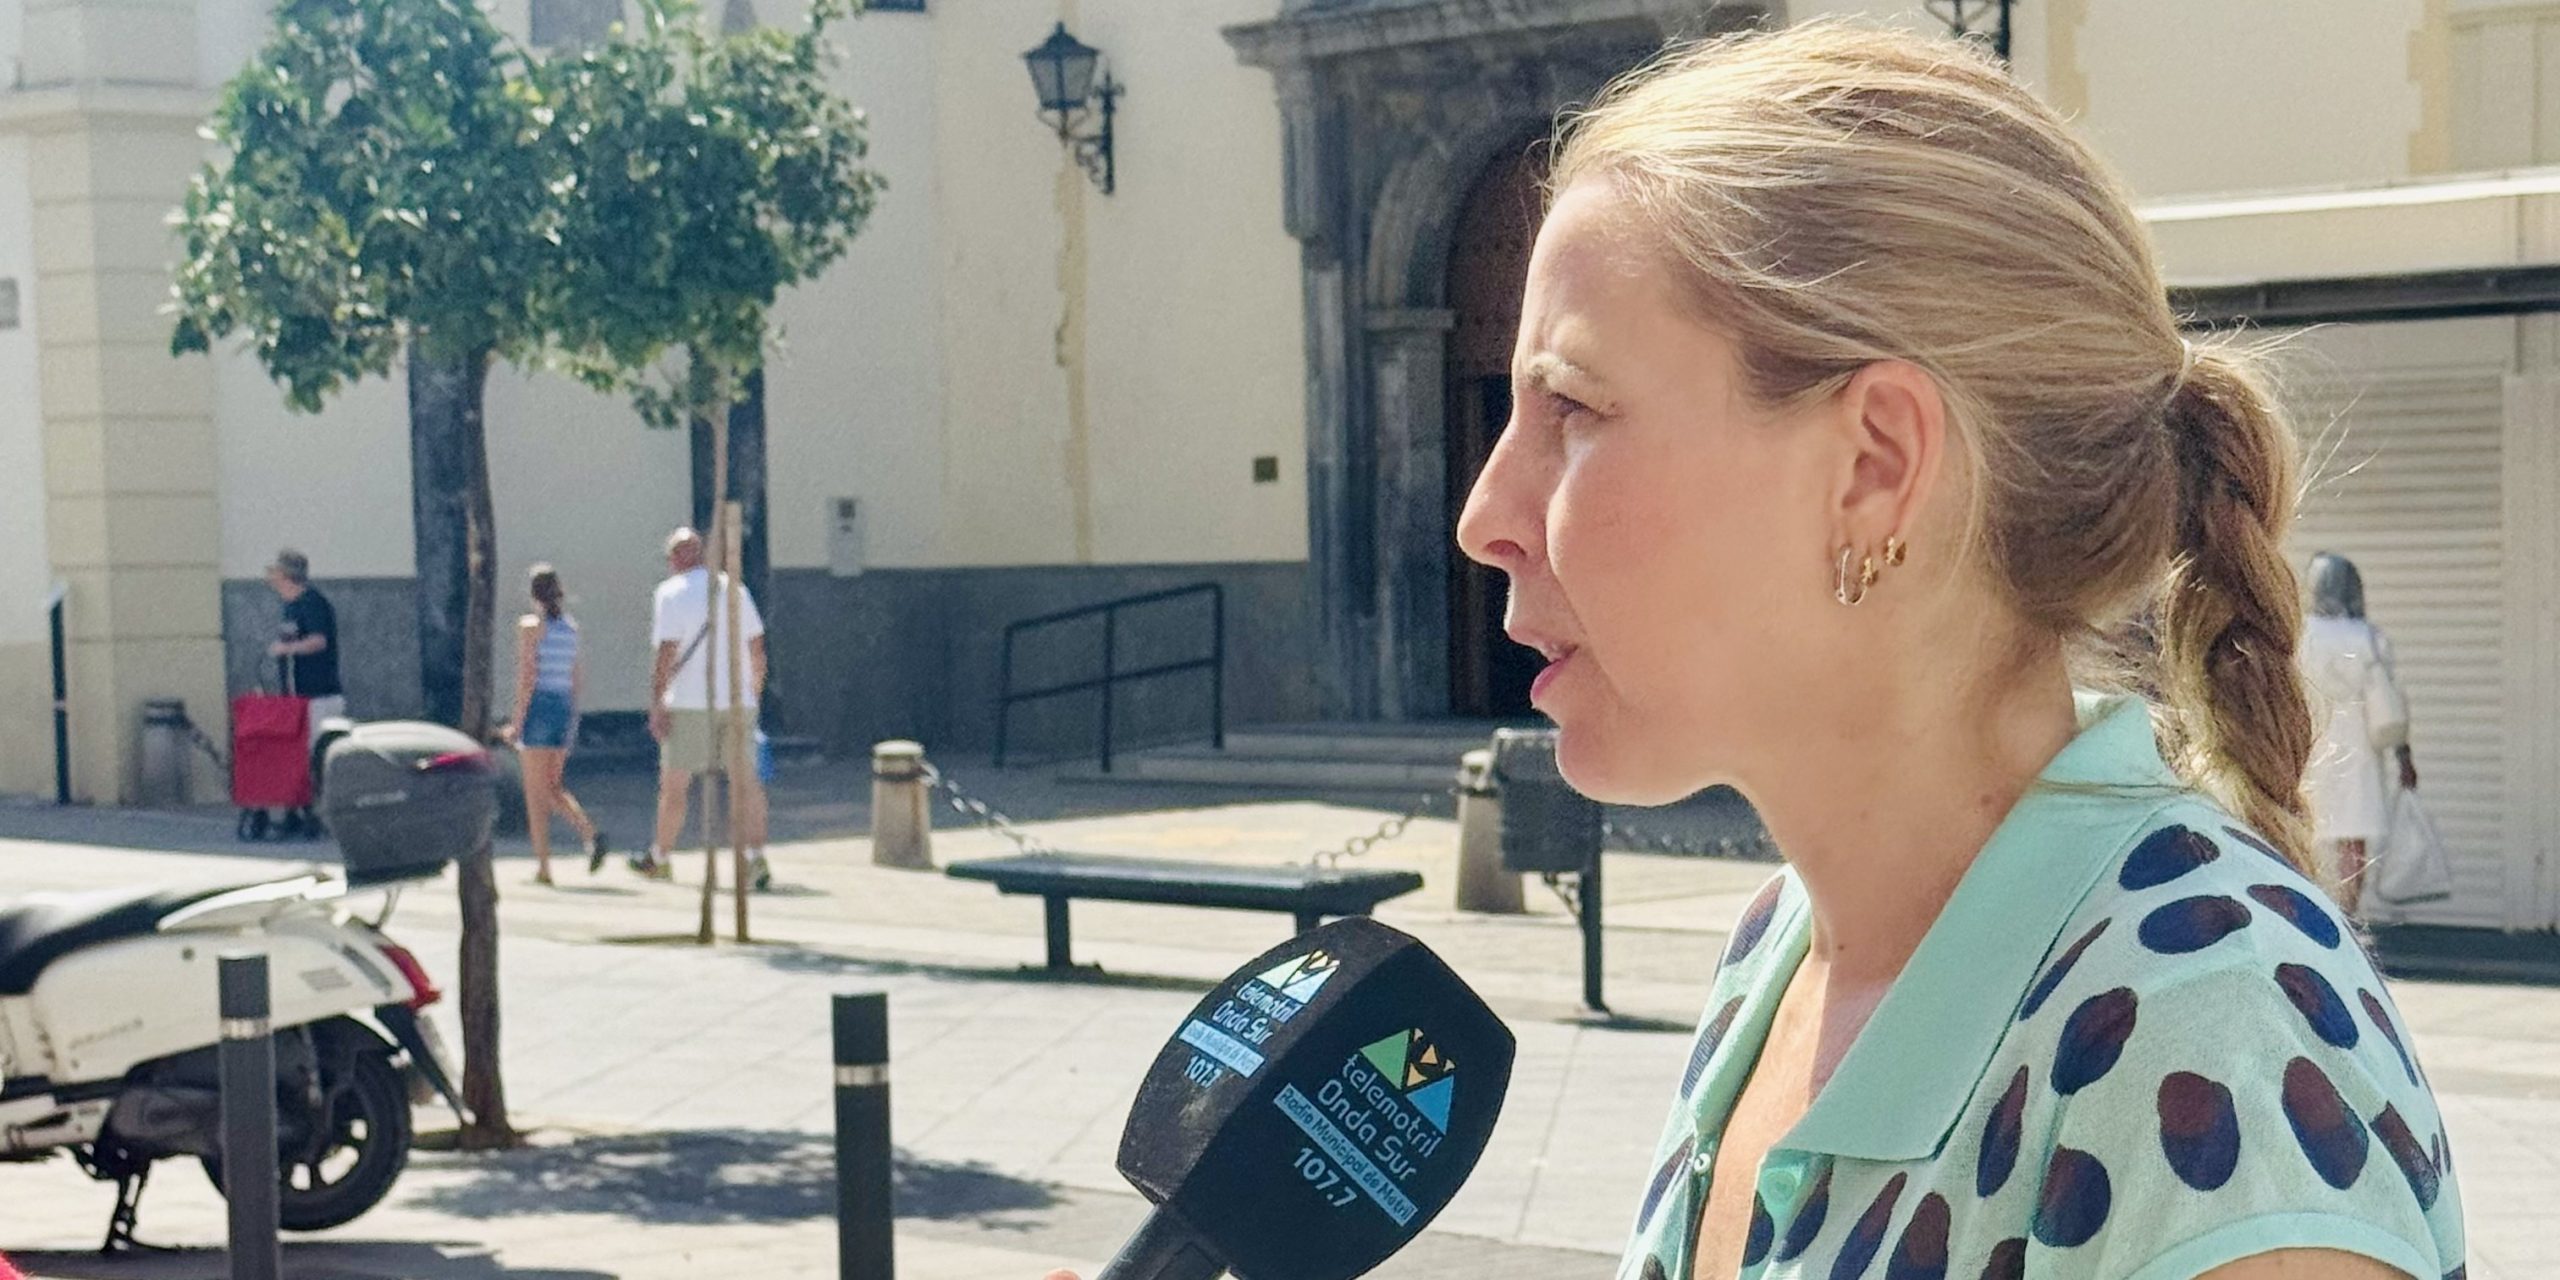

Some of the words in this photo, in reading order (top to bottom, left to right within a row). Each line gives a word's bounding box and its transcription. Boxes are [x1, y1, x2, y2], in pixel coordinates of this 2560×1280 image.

[1212, 1000, 1250, 1032] Onda
[1242, 1017, 1274, 1045] Sur
[1184, 1055, 1222, 1088] 107.7
[1342, 1053, 1443, 1158] telemotril
[1279, 1087, 1314, 1125] Radio
[1311, 1117, 1370, 1175] Municipal
[1362, 1171, 1380, 1189] de
[1375, 1181, 1416, 1221] Motril
[1317, 1079, 1377, 1145] Onda
[1374, 1135, 1418, 1180] Sur
[1294, 1147, 1358, 1208] 107.7
